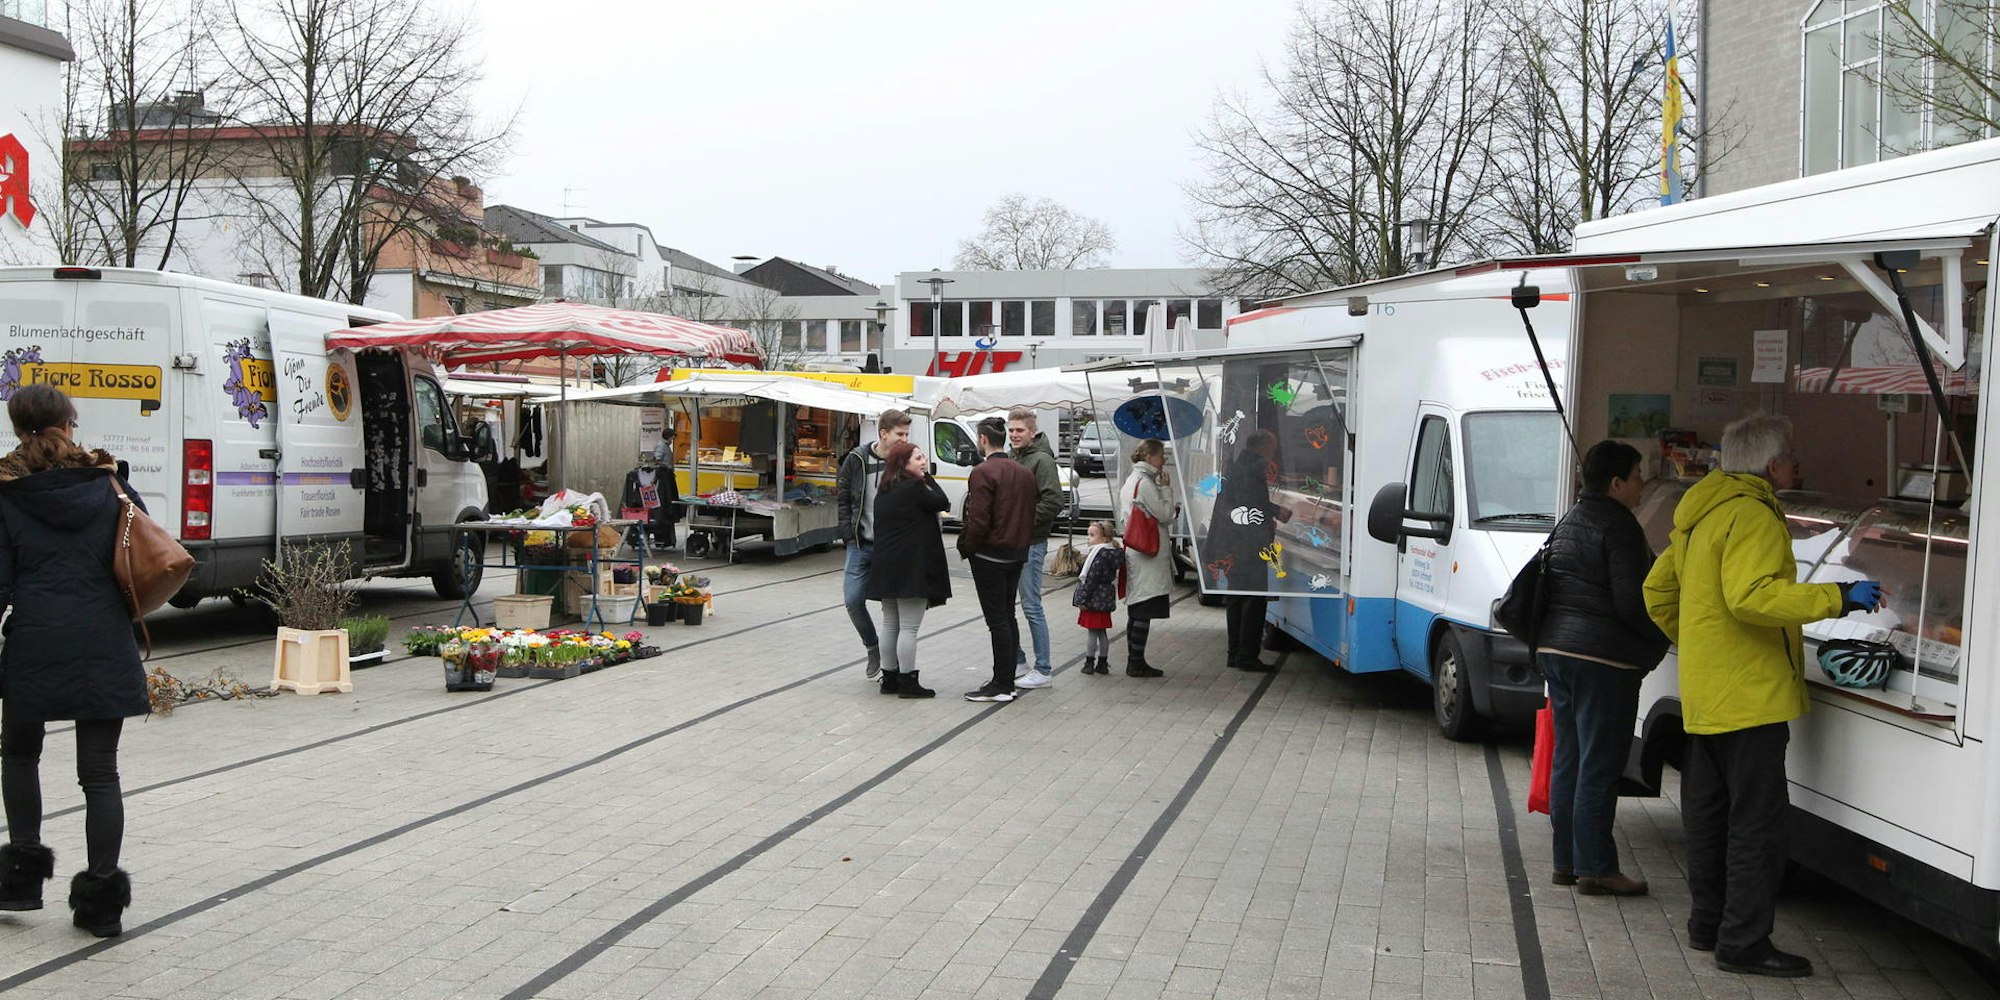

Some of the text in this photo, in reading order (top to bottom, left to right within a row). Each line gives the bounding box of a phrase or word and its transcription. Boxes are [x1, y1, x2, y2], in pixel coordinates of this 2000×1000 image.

[9, 325, 145, 342] Blumenachgeschäft
[284, 357, 305, 379] Gönn
[925, 351, 1023, 378] HIT
[89, 369, 157, 389] Rosso
[295, 375, 311, 393] Dir
[1525, 381, 1564, 390] Fish
[293, 391, 324, 424] Freude
[300, 506, 341, 518] Fair trade Rosen
